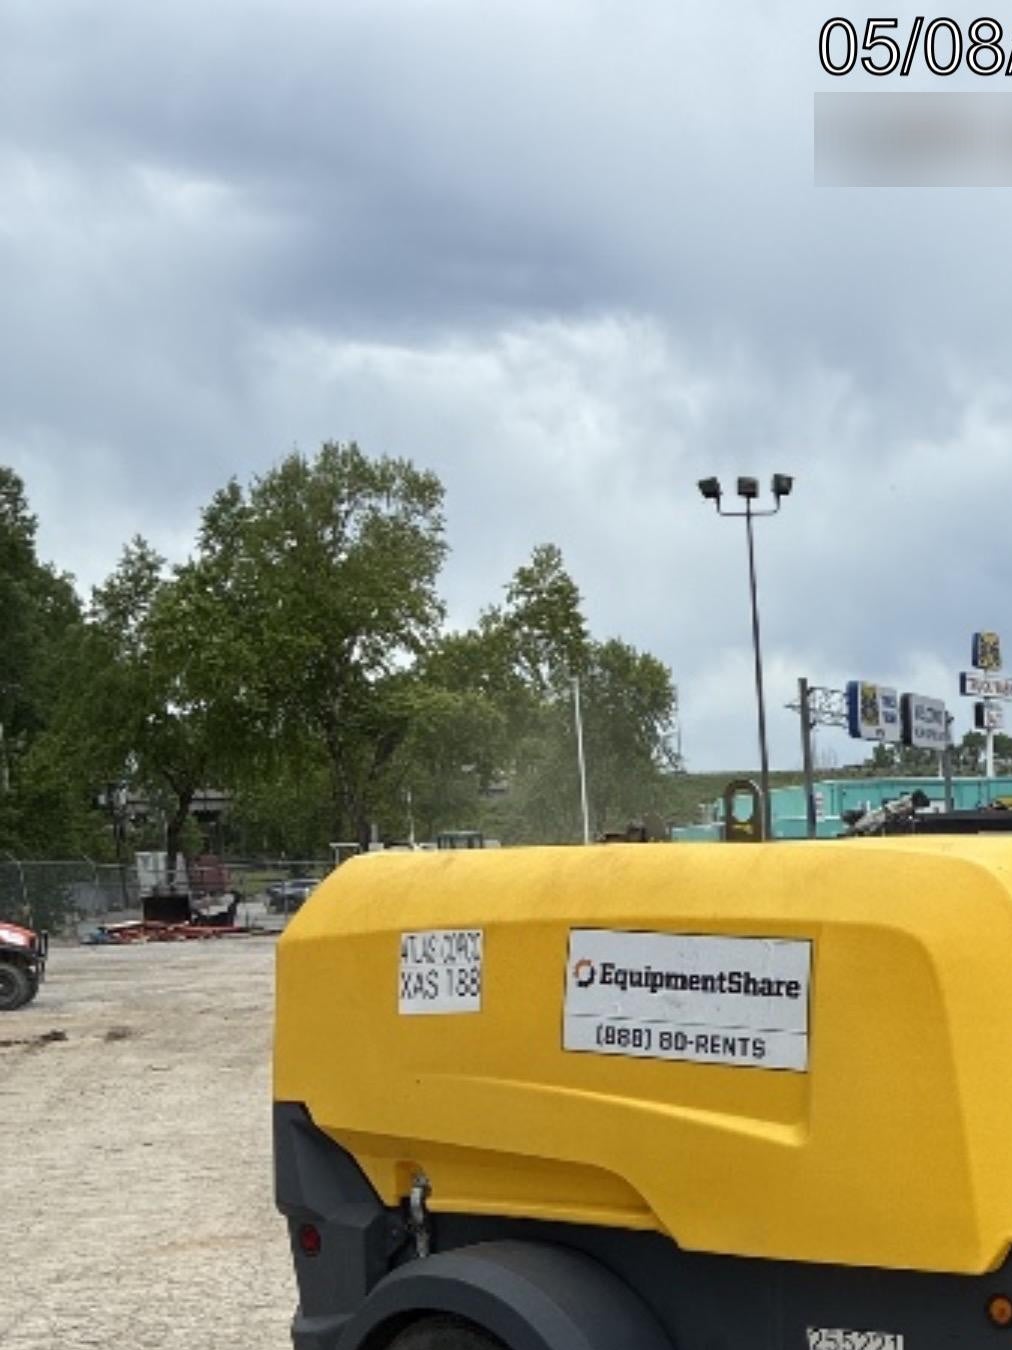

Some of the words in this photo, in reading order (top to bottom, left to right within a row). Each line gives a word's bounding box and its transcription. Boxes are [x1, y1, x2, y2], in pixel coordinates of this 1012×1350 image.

[401, 968, 439, 999] XAS
[446, 967, 480, 997] 188
[599, 962, 801, 998] EquipmentShare
[596, 1024, 652, 1050] (888)
